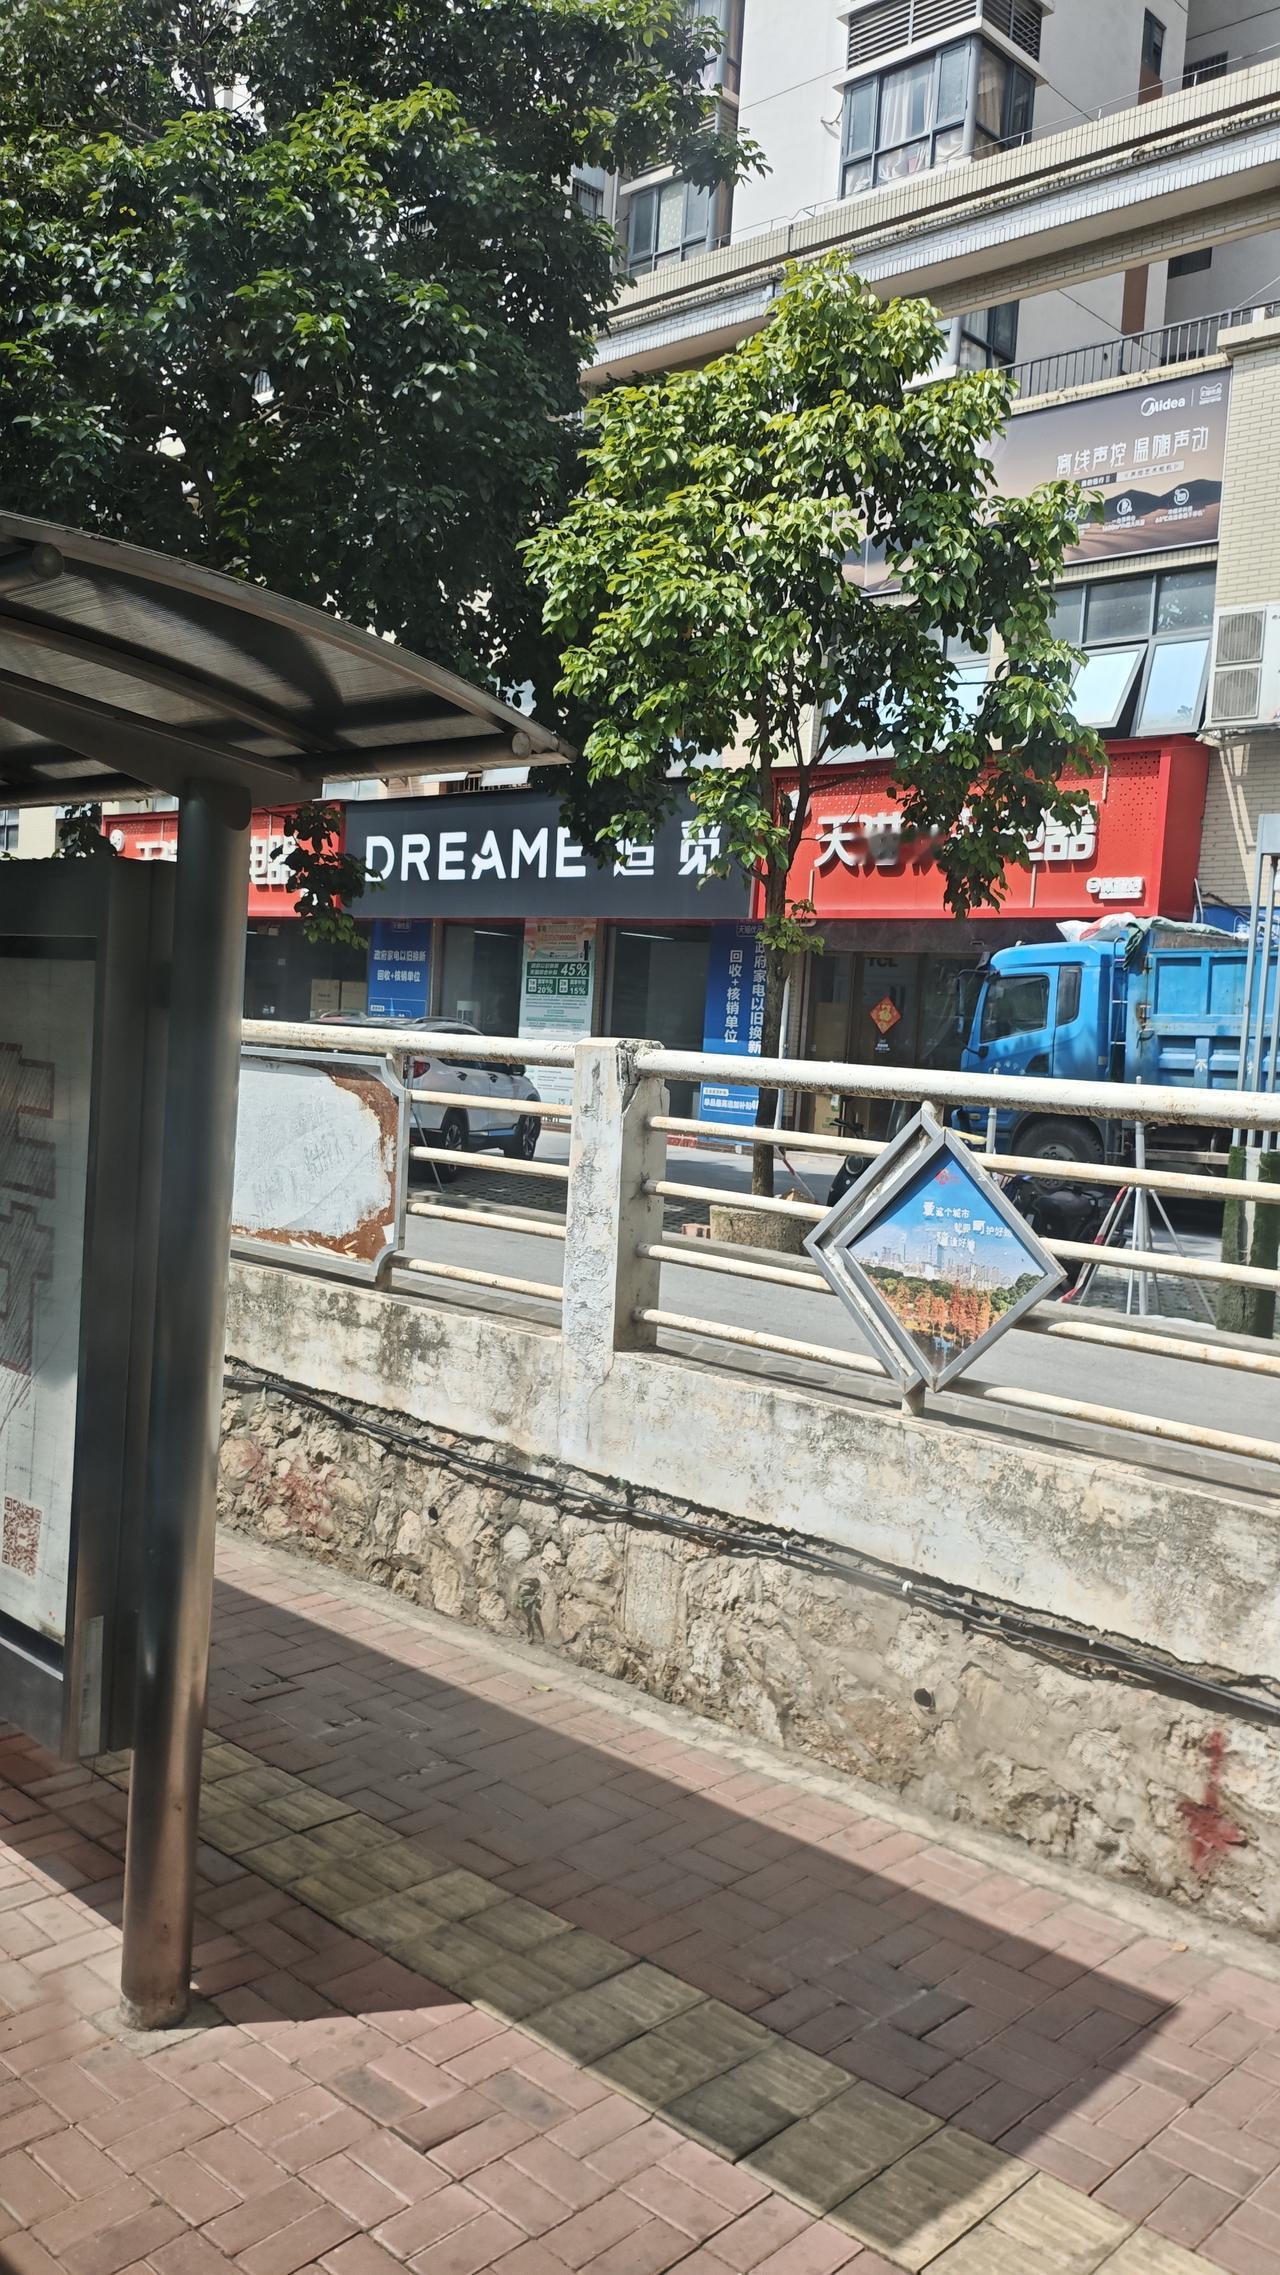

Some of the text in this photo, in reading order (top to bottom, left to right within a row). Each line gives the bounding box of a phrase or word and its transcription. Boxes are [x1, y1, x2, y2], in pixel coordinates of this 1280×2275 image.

[1141, 397, 1186, 416] Midea
[1056, 442, 1127, 479] 离线声控
[364, 826, 588, 883] DREAME
[373, 950, 426, 962] 政府家电以旧换新
[377, 969, 421, 982] 回收+核销单位
[560, 963, 587, 977] 45%
[724, 949, 744, 1043] 回收+核销单位
